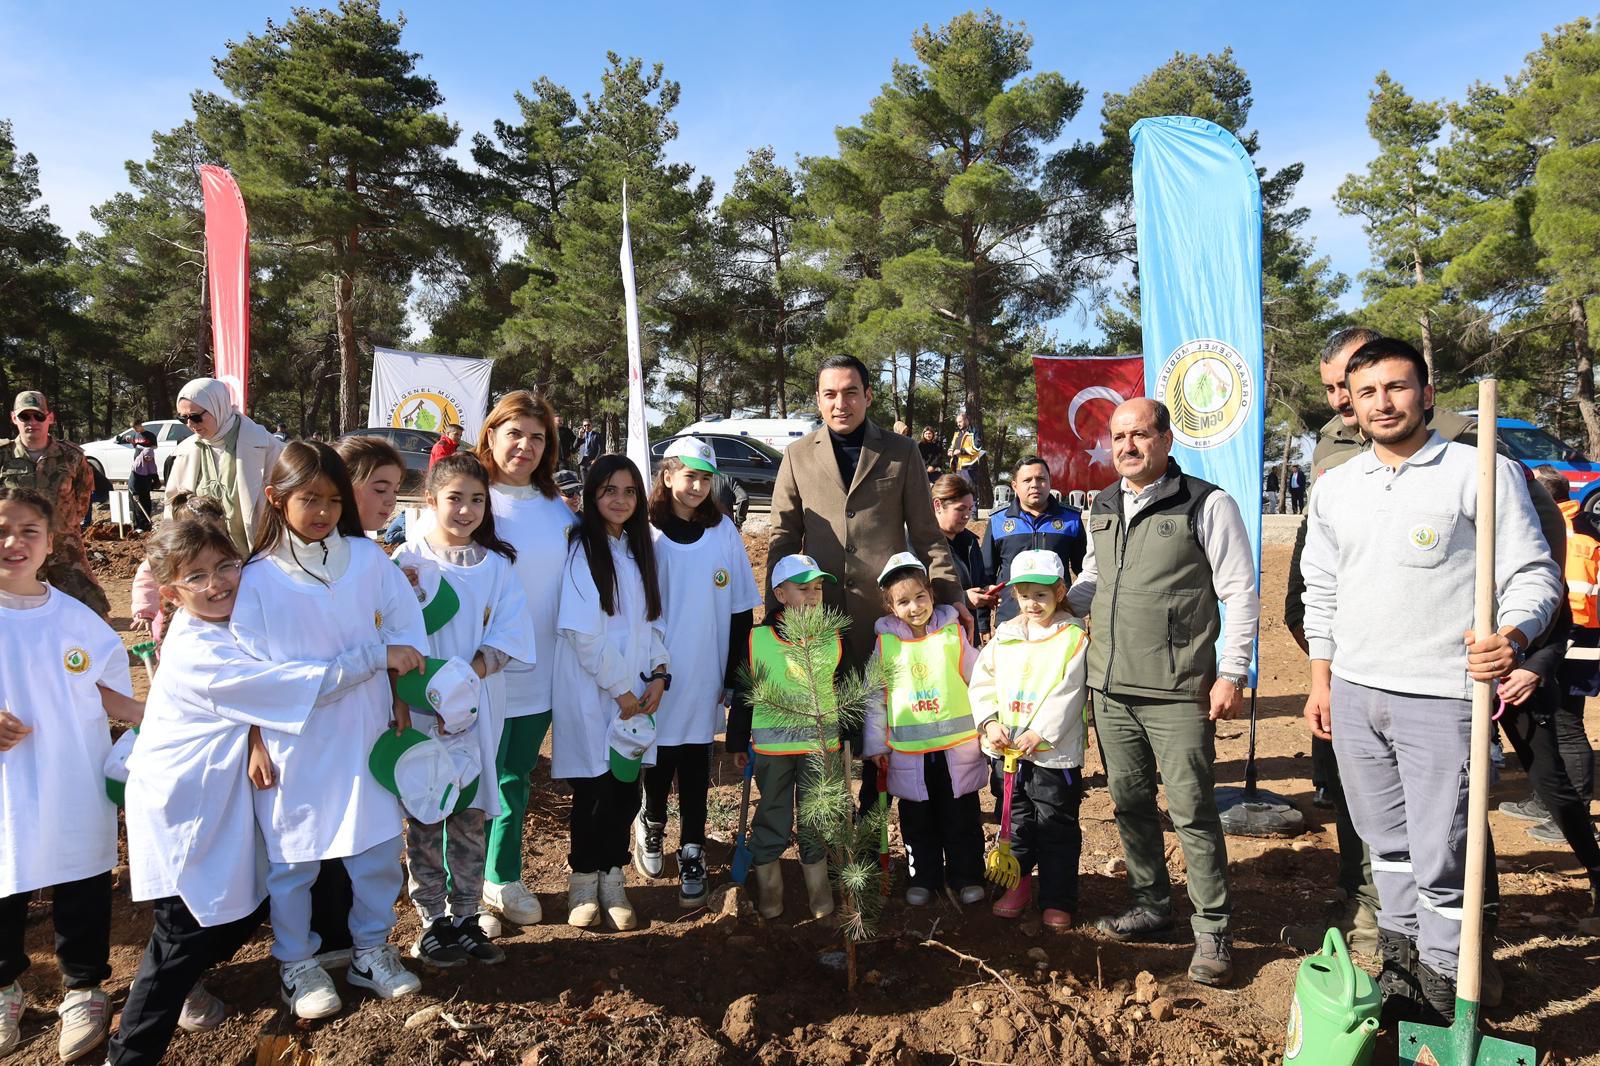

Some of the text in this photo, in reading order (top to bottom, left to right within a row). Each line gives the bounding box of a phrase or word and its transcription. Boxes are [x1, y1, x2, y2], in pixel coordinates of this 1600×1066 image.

[386, 402, 399, 427] RMAN
[401, 387, 432, 399] GENEL
[911, 698, 940, 714] KREŞ
